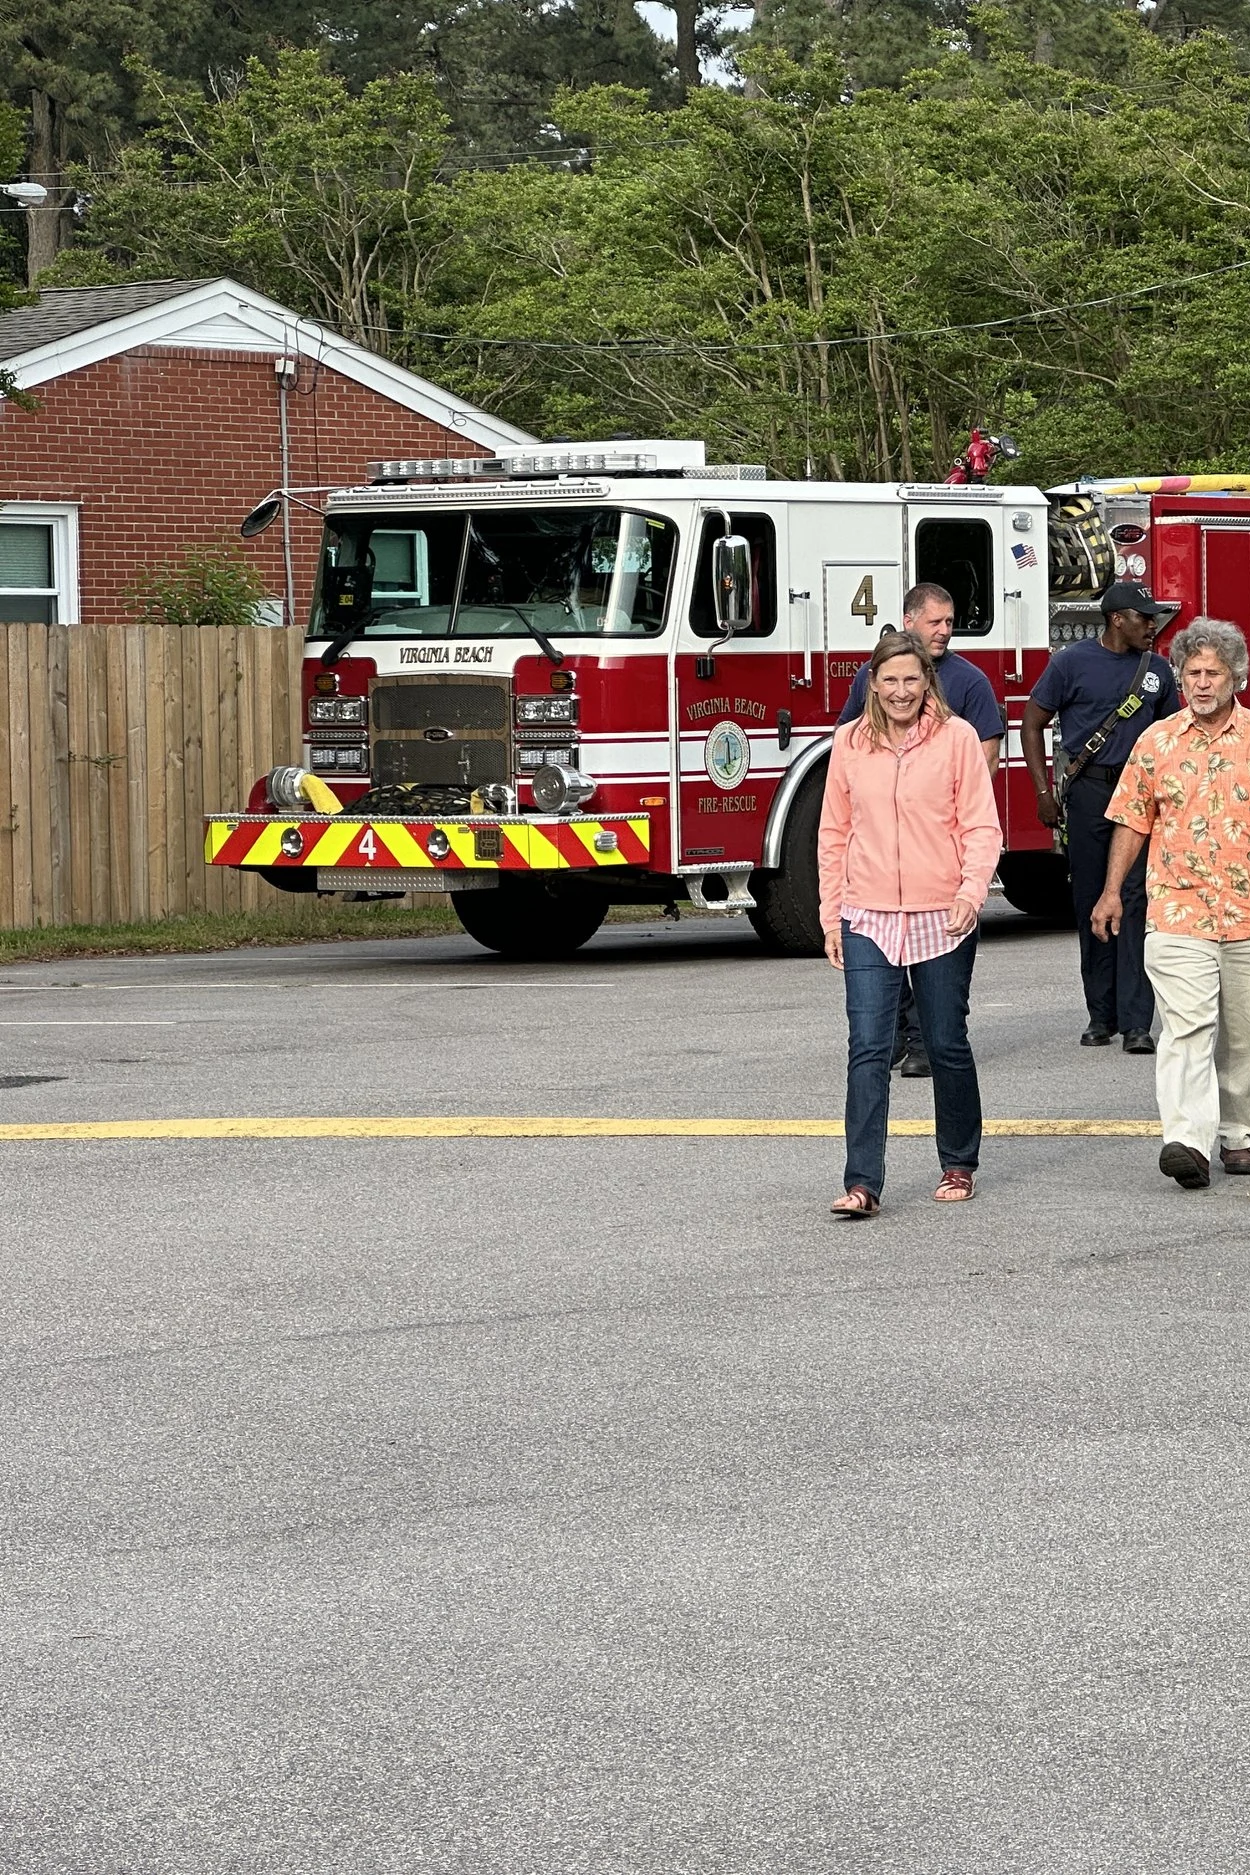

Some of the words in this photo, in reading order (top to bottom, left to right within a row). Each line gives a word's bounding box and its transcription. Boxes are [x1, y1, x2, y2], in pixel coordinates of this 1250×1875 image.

[851, 575, 877, 626] 4
[399, 647, 450, 663] VIRGINIA
[453, 646, 494, 663] BEACH
[829, 661, 863, 677] CHES
[686, 697, 731, 721] VIRGINIA
[734, 697, 767, 721] BEACH
[698, 795, 757, 814] FIRE-RESCUE
[358, 828, 377, 861] 4
